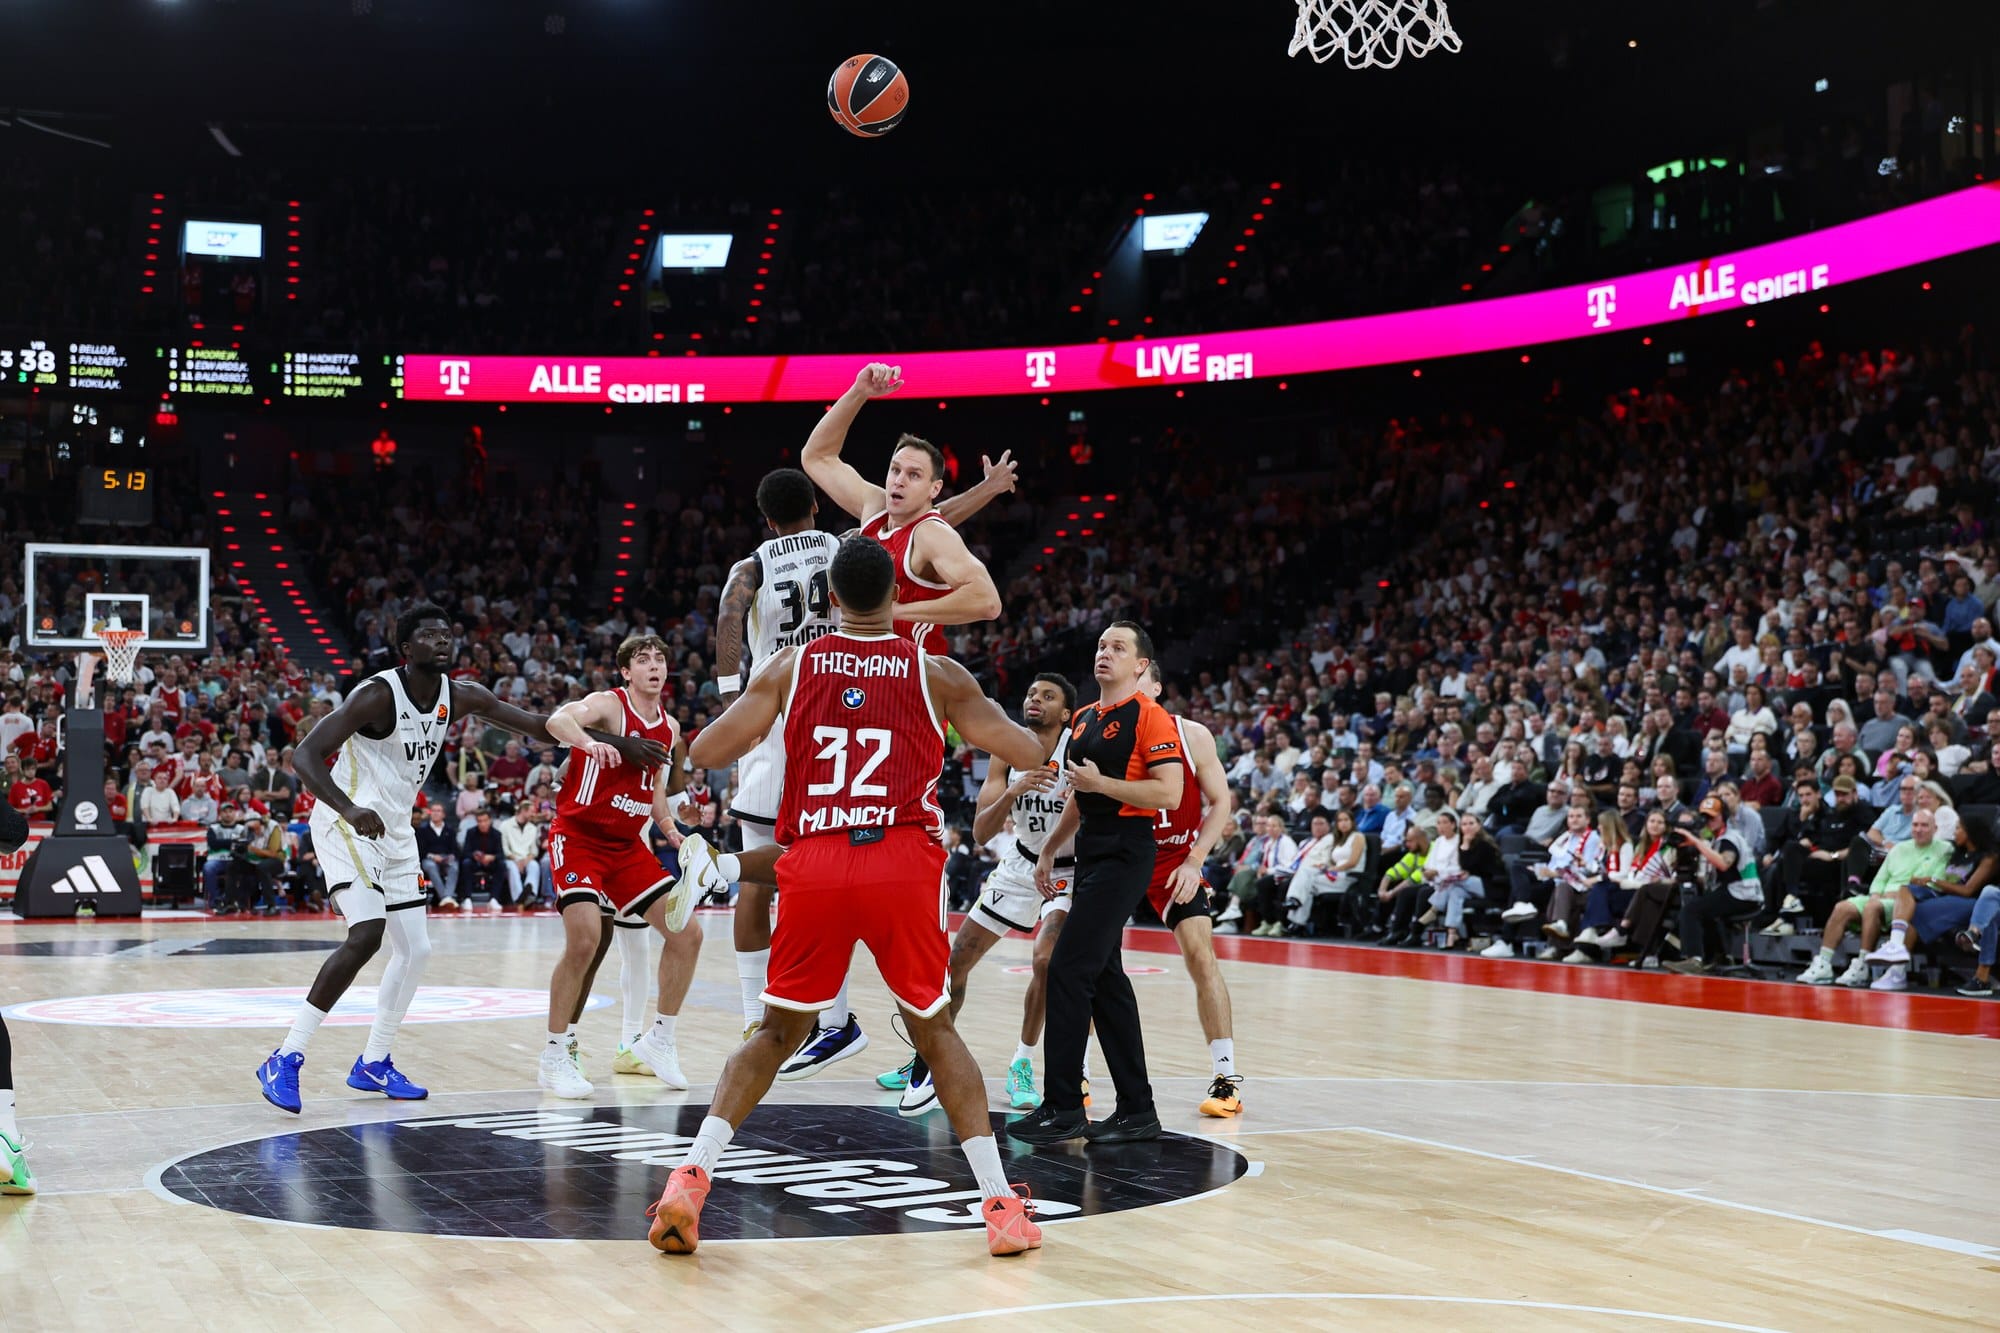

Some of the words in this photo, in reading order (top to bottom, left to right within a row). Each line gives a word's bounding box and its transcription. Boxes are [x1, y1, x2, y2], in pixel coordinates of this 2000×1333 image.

[1669, 263, 1736, 310] ALLE
[20, 349, 56, 372] 38
[1136, 343, 1201, 378] LIVE
[529, 365, 601, 393] ALLE
[773, 568, 831, 633] 34
[810, 652, 909, 679] THIEMANN
[808, 726, 892, 797] 32
[1015, 794, 1065, 814] Virtus
[799, 806, 898, 836] MUNICH
[1028, 816, 1047, 832] 21
